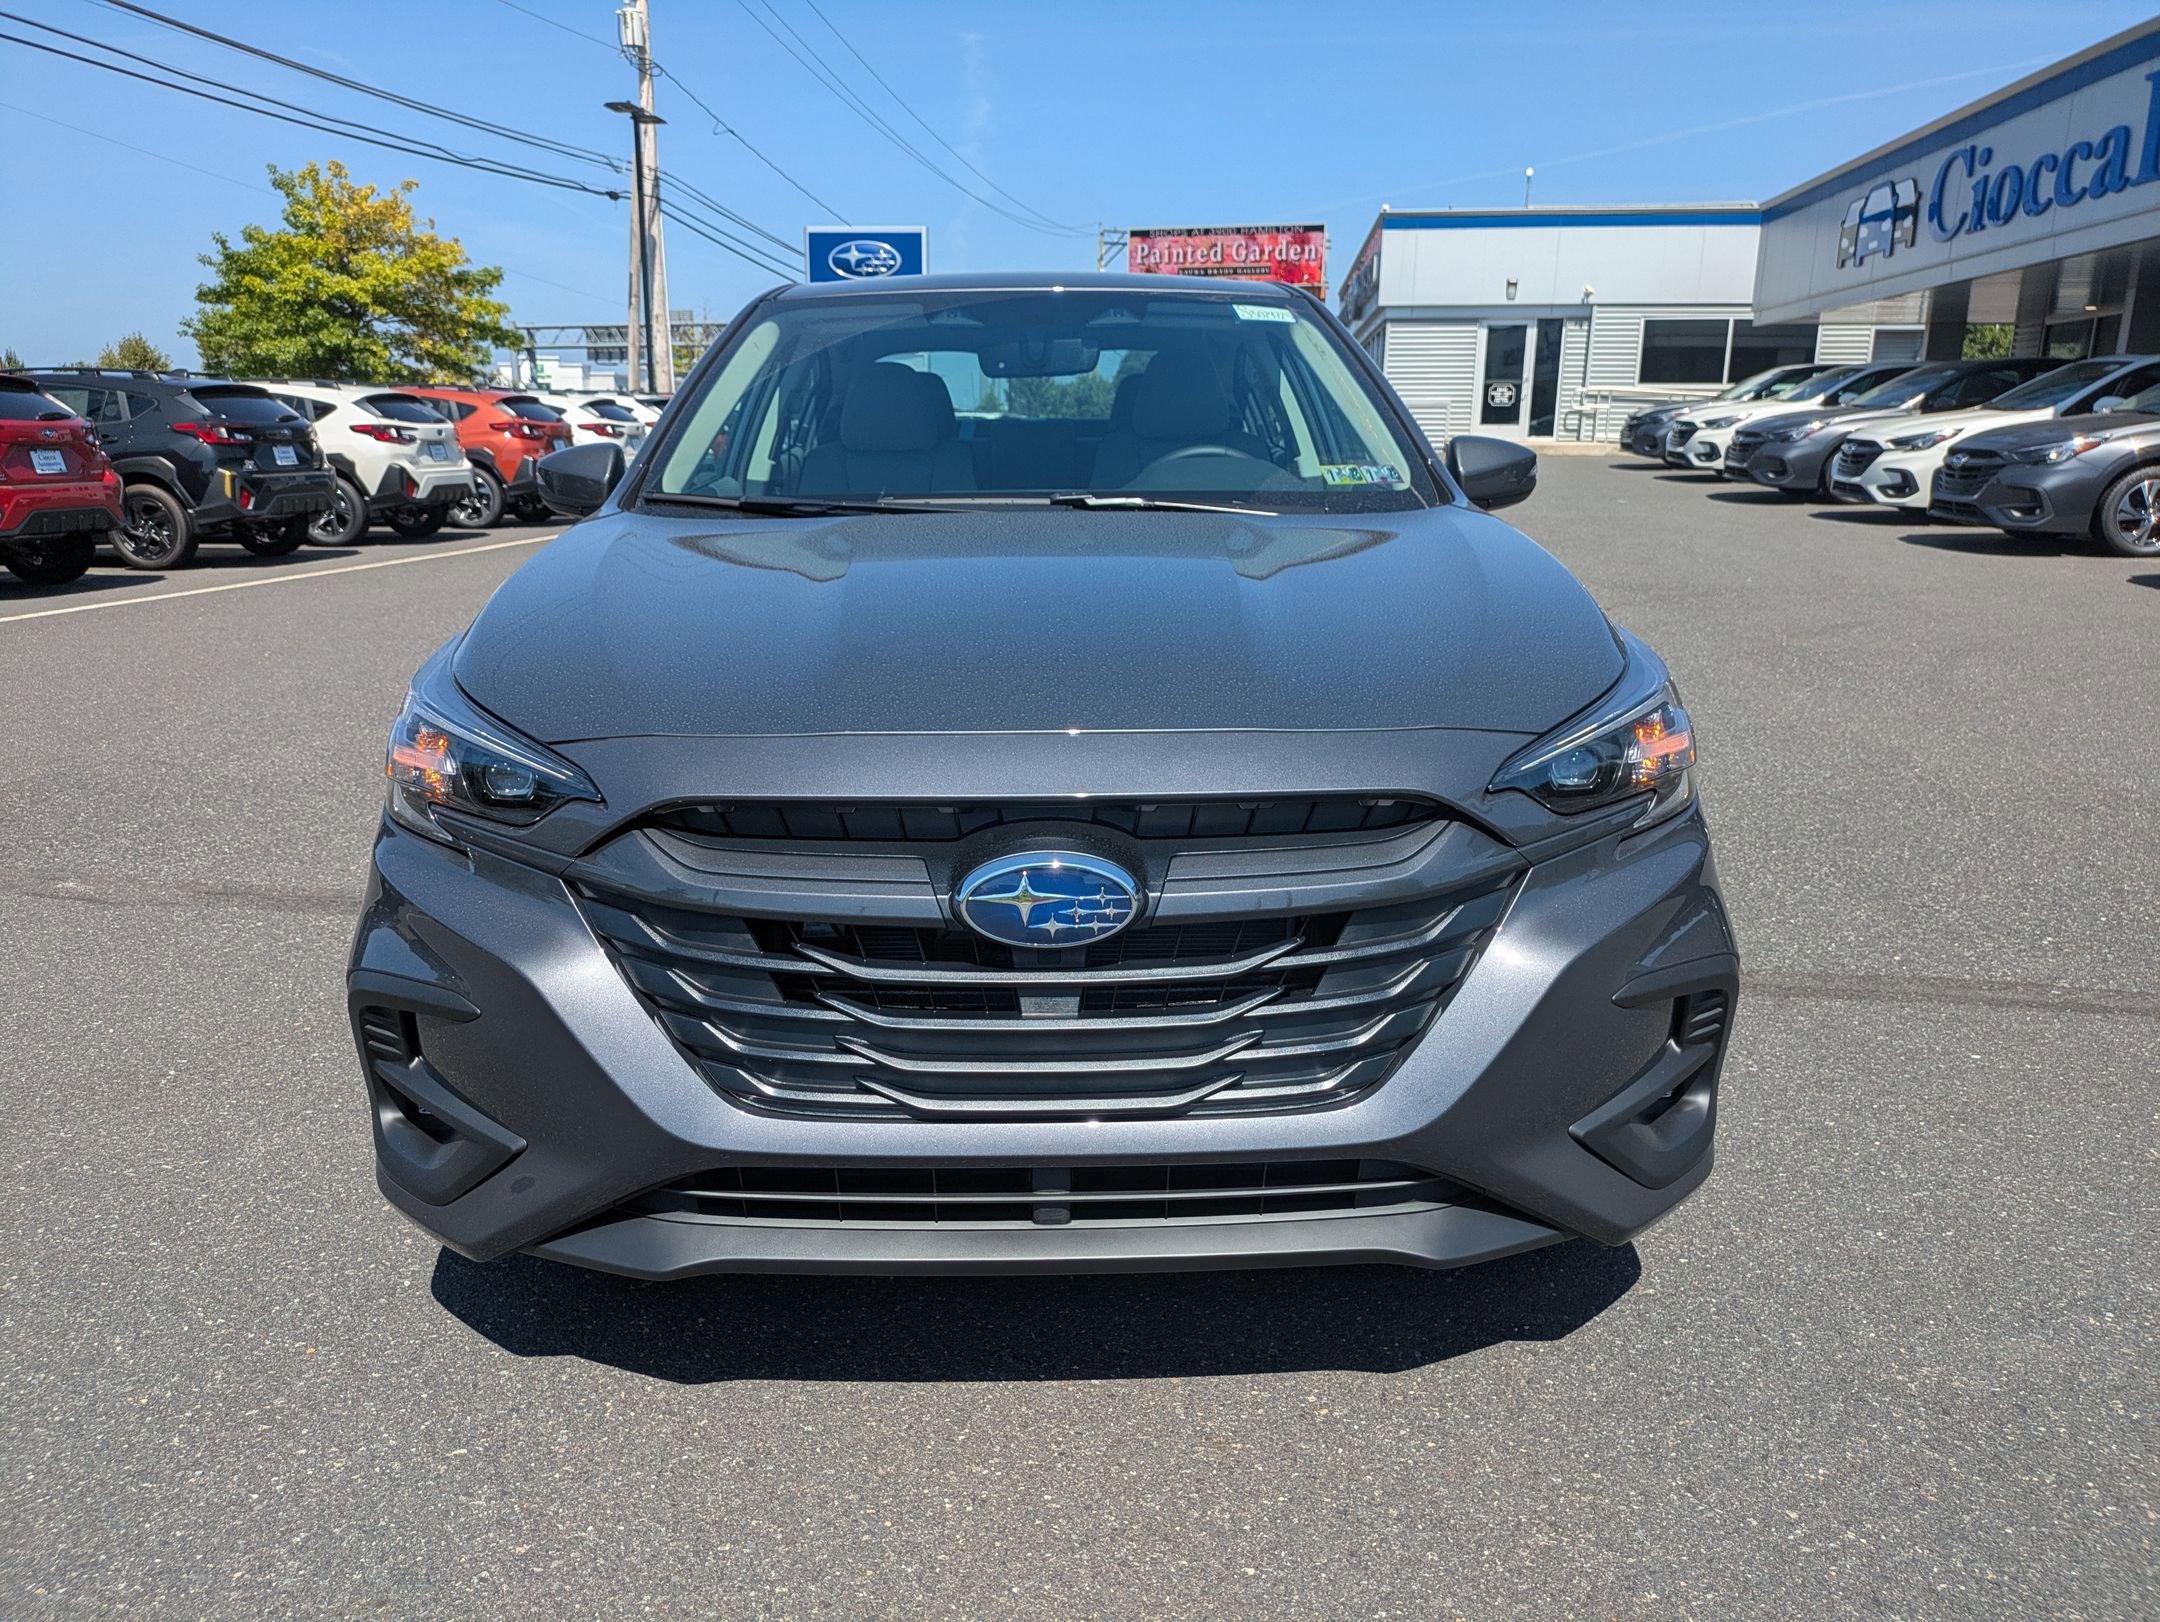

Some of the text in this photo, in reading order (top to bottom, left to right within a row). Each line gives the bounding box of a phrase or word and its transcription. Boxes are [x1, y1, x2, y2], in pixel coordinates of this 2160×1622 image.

[1928, 125, 2130, 243] Ciocca
[1240, 225, 1305, 236] HAMILTON
[1136, 240, 1317, 264] Painted Garden
